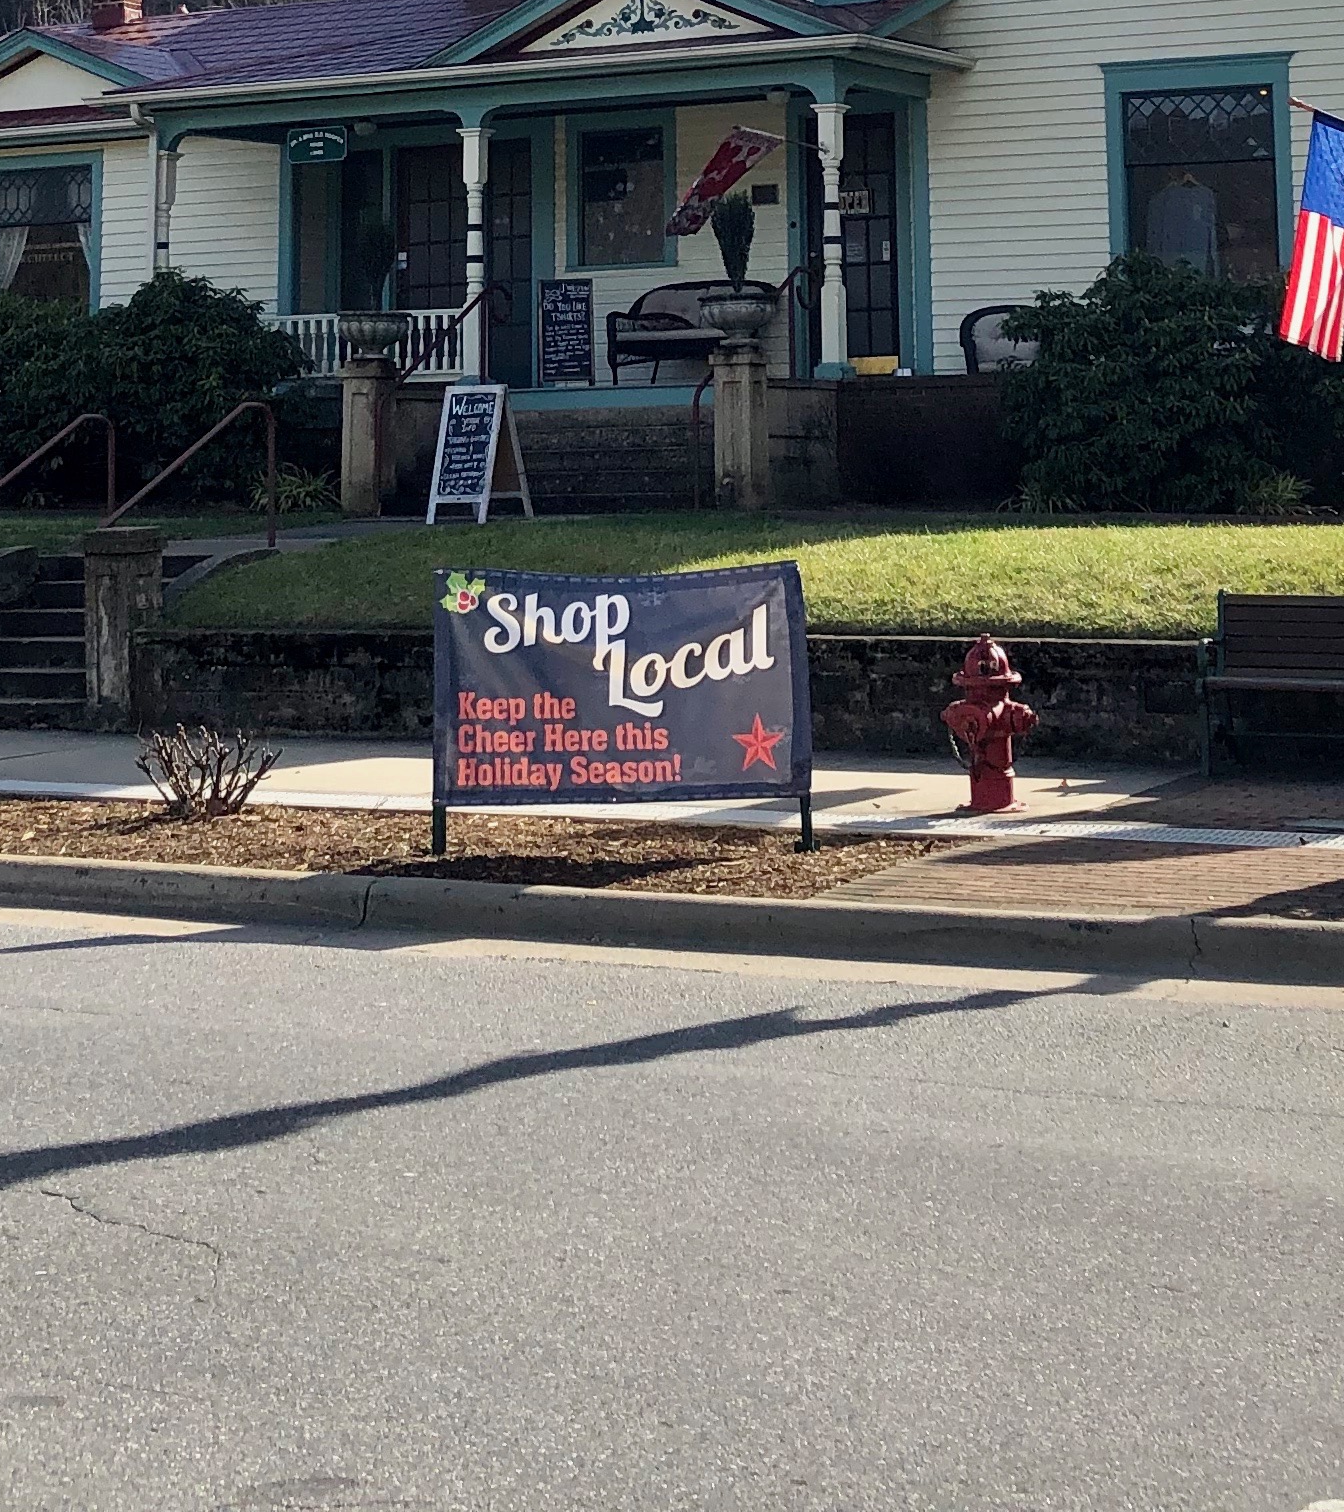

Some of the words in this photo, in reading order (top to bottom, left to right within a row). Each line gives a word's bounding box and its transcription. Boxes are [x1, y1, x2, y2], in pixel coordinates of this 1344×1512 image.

[452, 396, 494, 415] WELCOME
[483, 591, 631, 671] Shop
[607, 602, 775, 718] Local
[457, 691, 526, 726] Keep
[533, 691, 576, 720] the
[458, 724, 537, 754] Cheer
[543, 723, 608, 752] Here
[615, 721, 670, 751] this
[457, 758, 563, 792] Holiday
[569, 754, 682, 785] Season!
